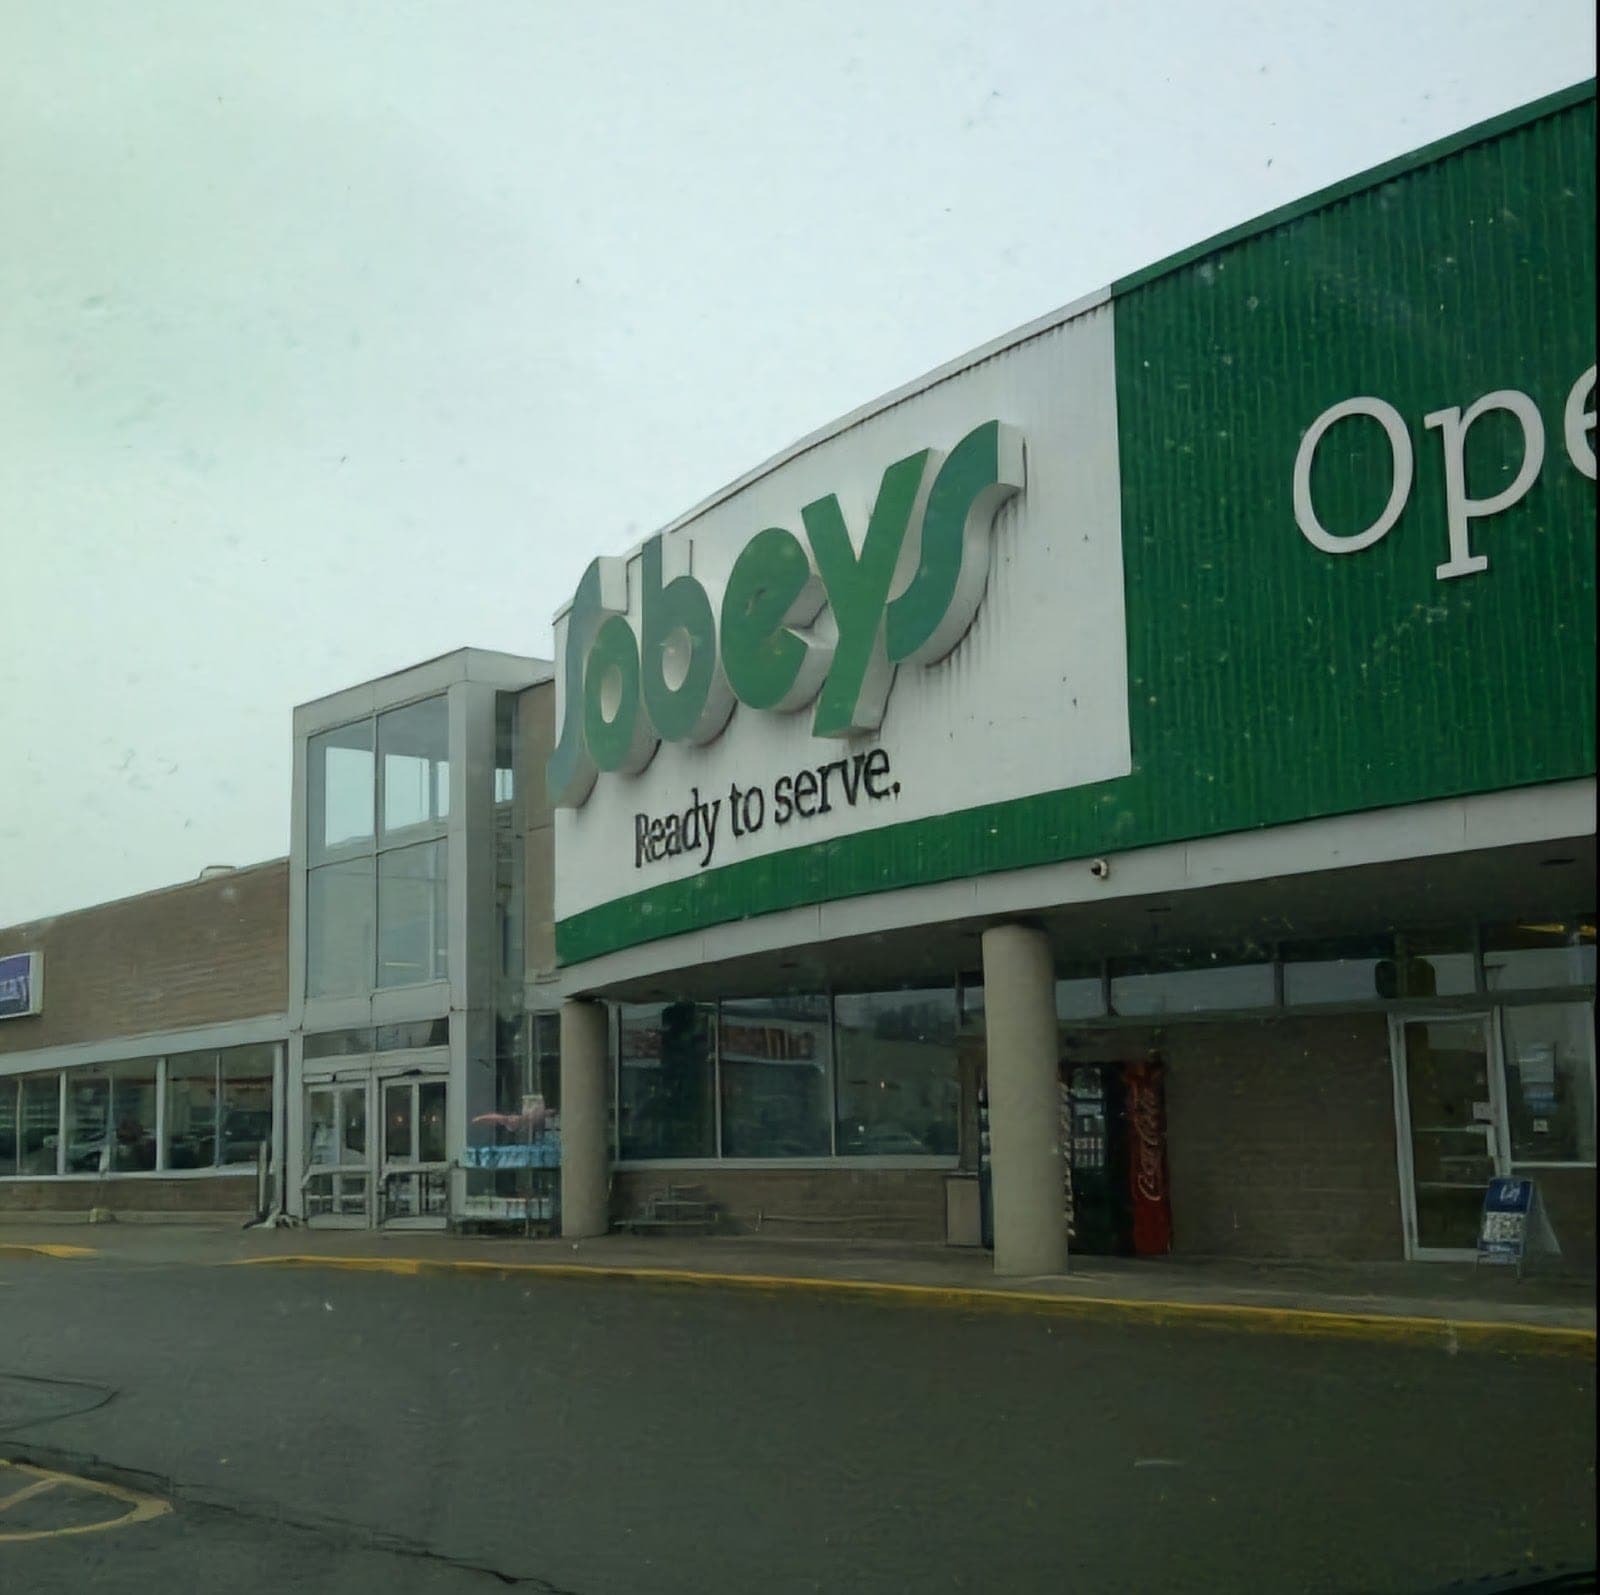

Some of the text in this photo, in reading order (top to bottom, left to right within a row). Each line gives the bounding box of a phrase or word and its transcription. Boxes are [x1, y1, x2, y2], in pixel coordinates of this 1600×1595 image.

[546, 419, 1003, 803] Sobeys
[635, 748, 901, 868] Ready to serve.
